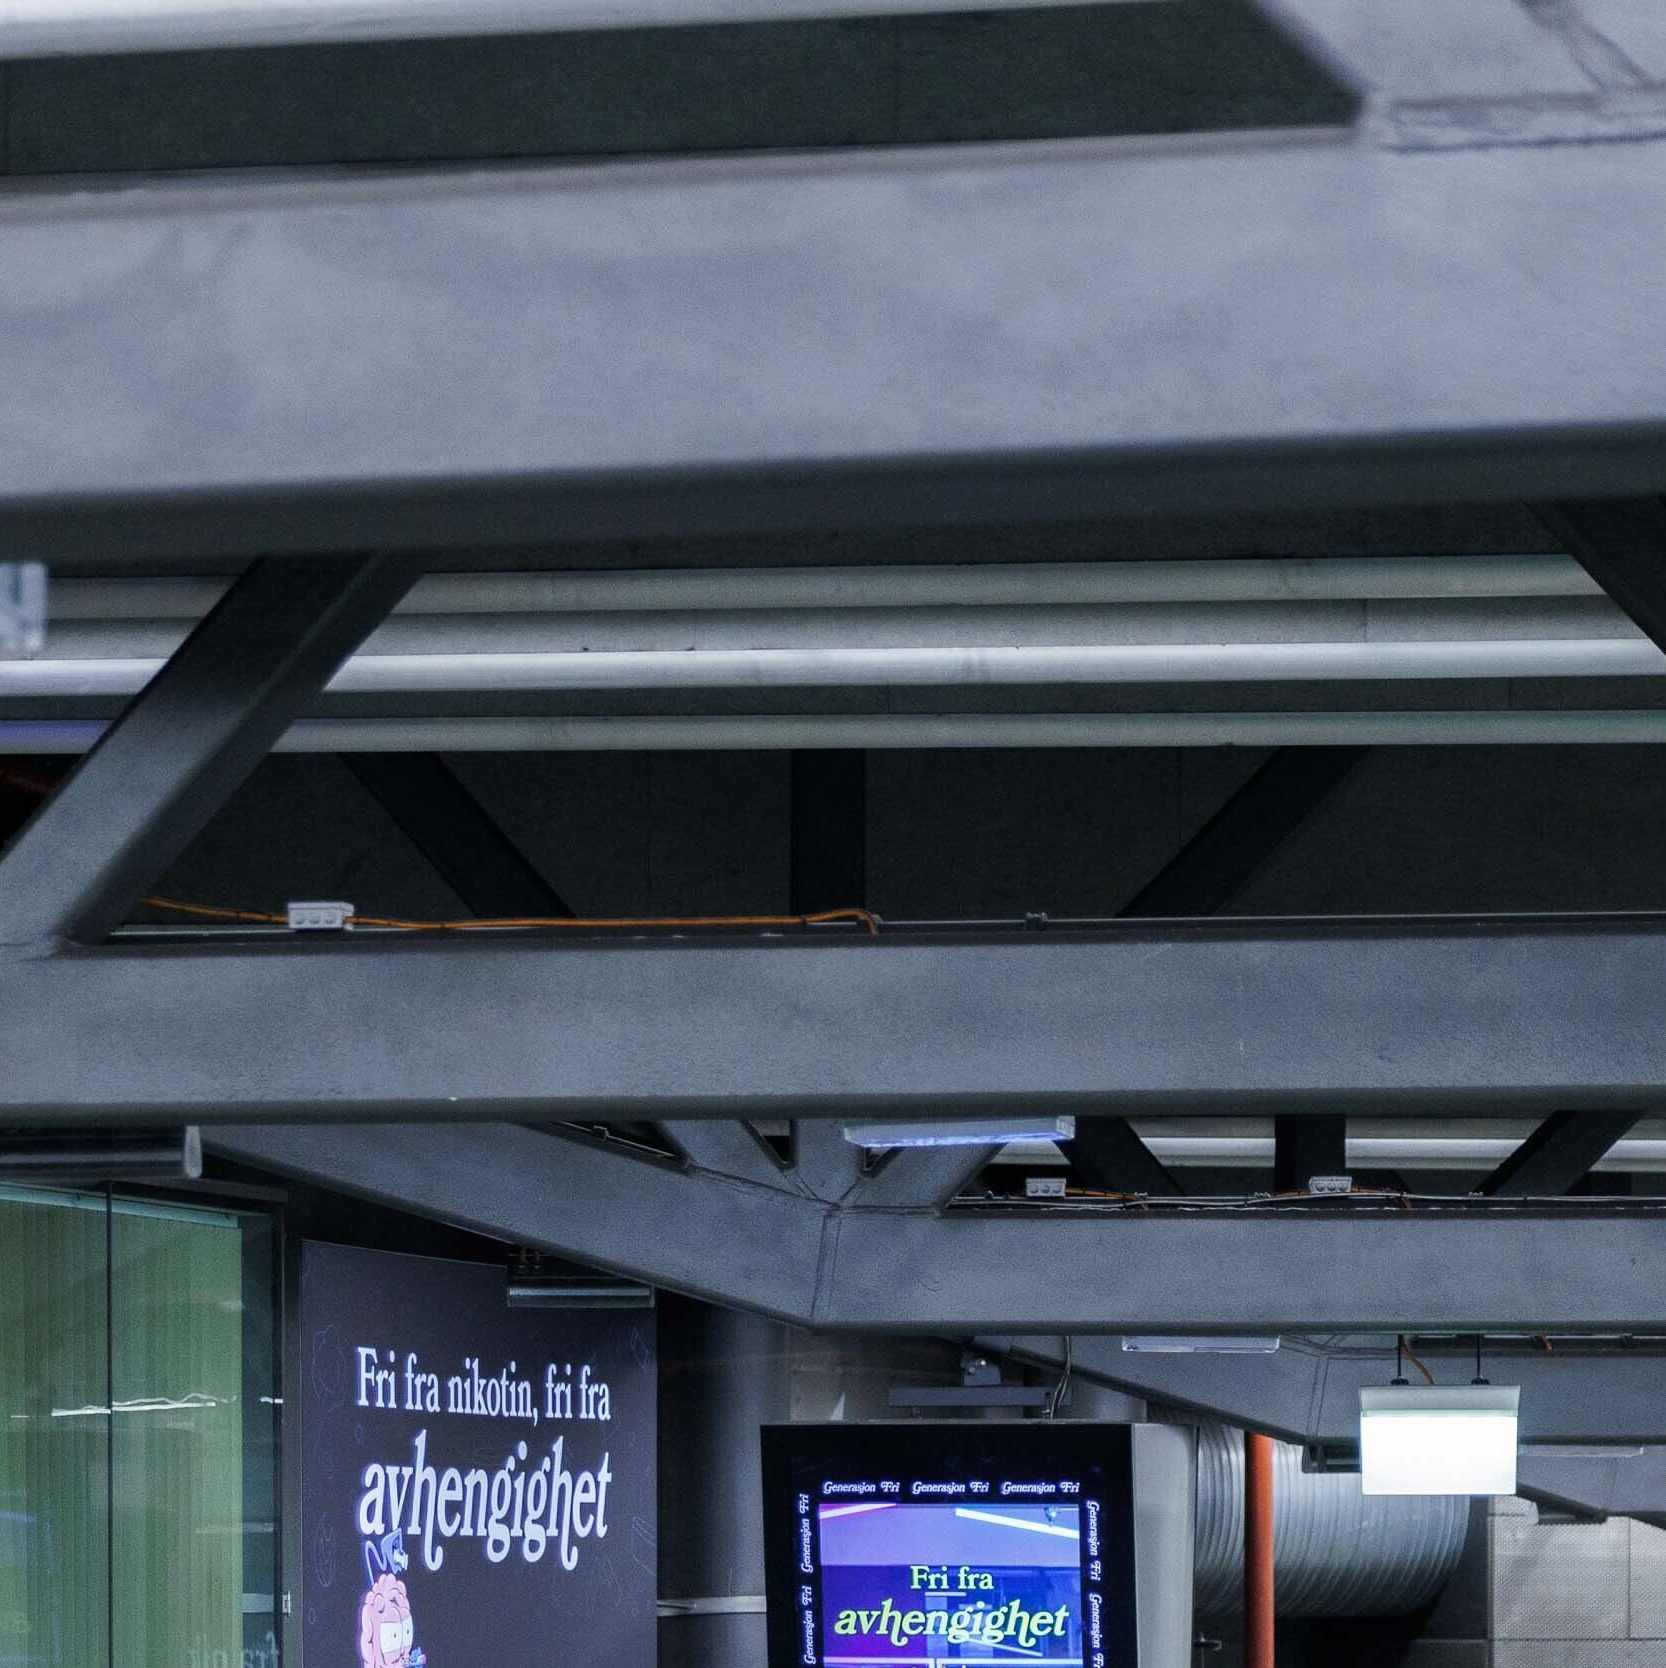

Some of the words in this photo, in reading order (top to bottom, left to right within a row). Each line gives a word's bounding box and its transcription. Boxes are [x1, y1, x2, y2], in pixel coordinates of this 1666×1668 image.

[357, 1345, 396, 1409] Fri
[405, 1353, 440, 1412] fra
[447, 1358, 539, 1426] nikotin,
[545, 1363, 573, 1419] fri
[579, 1366, 611, 1420] fra
[359, 1429, 612, 1571] avhengighet
[799, 1493, 809, 1514] Fri
[822, 1481, 876, 1495] Generasjon
[880, 1481, 901, 1493] Fri
[912, 1481, 966, 1495] Generasjon
[969, 1481, 990, 1493] Fri
[1000, 1481, 1056, 1495] Generasjon
[1059, 1481, 1080, 1493] Fri
[800, 1518, 814, 1574] Generasjon
[1086, 1500, 1100, 1556] Generasjon
[910, 1565, 951, 1591] Fri
[957, 1565, 994, 1591] fra
[1090, 1560, 1101, 1581] Fri
[801, 1585, 813, 1606] Fri
[803, 1610, 817, 1665] Generasjon
[835, 1599, 1068, 1647] avhengighet
[1089, 1592, 1103, 1649] Generasjon
